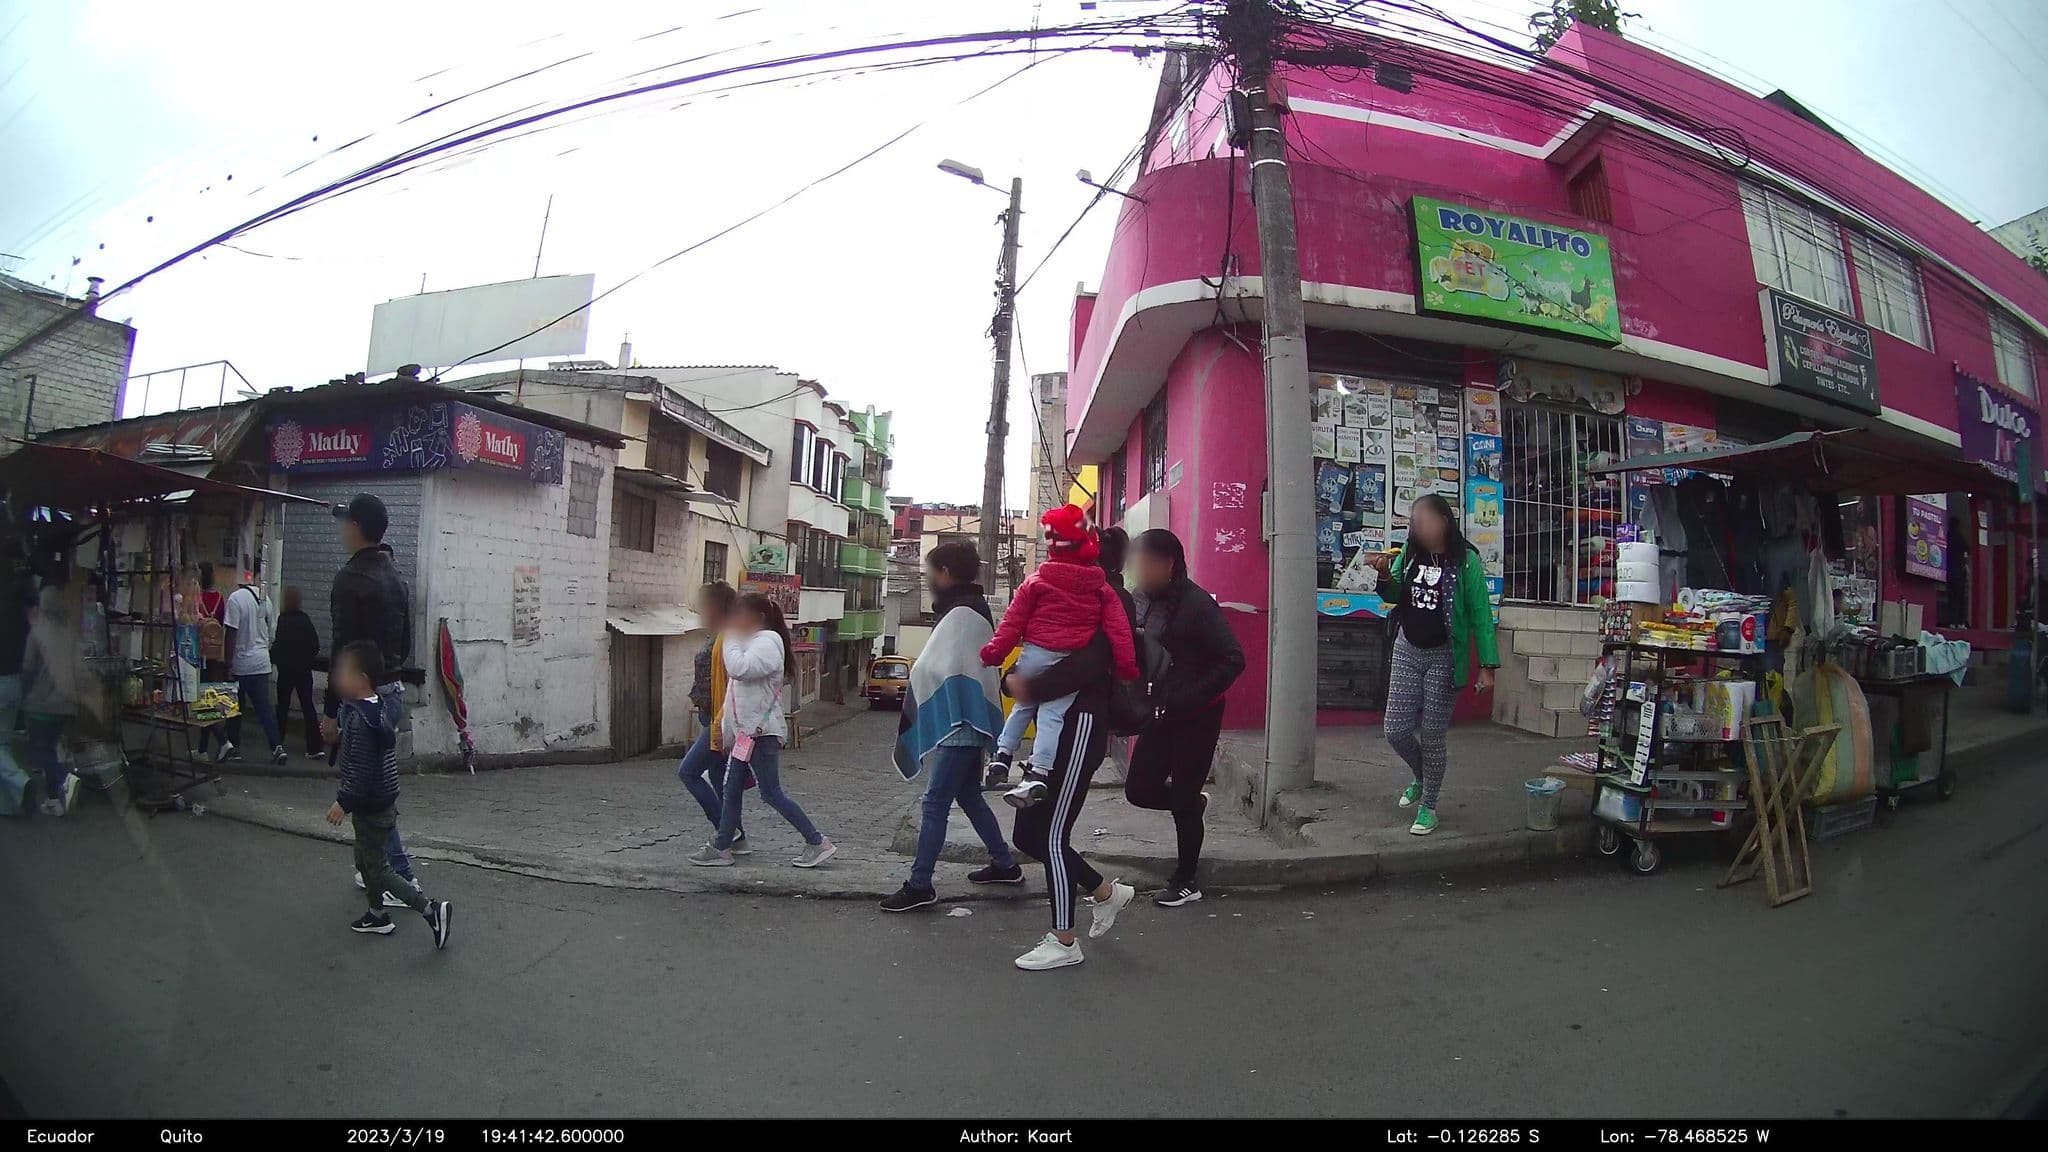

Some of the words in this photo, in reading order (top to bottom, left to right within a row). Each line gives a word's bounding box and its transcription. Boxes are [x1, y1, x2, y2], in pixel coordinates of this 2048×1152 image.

[1437, 207, 1592, 258] ROYALITO
[1978, 386, 2031, 438] Dulce
[309, 428, 362, 454] Mathy
[485, 431, 519, 462] Mathy
